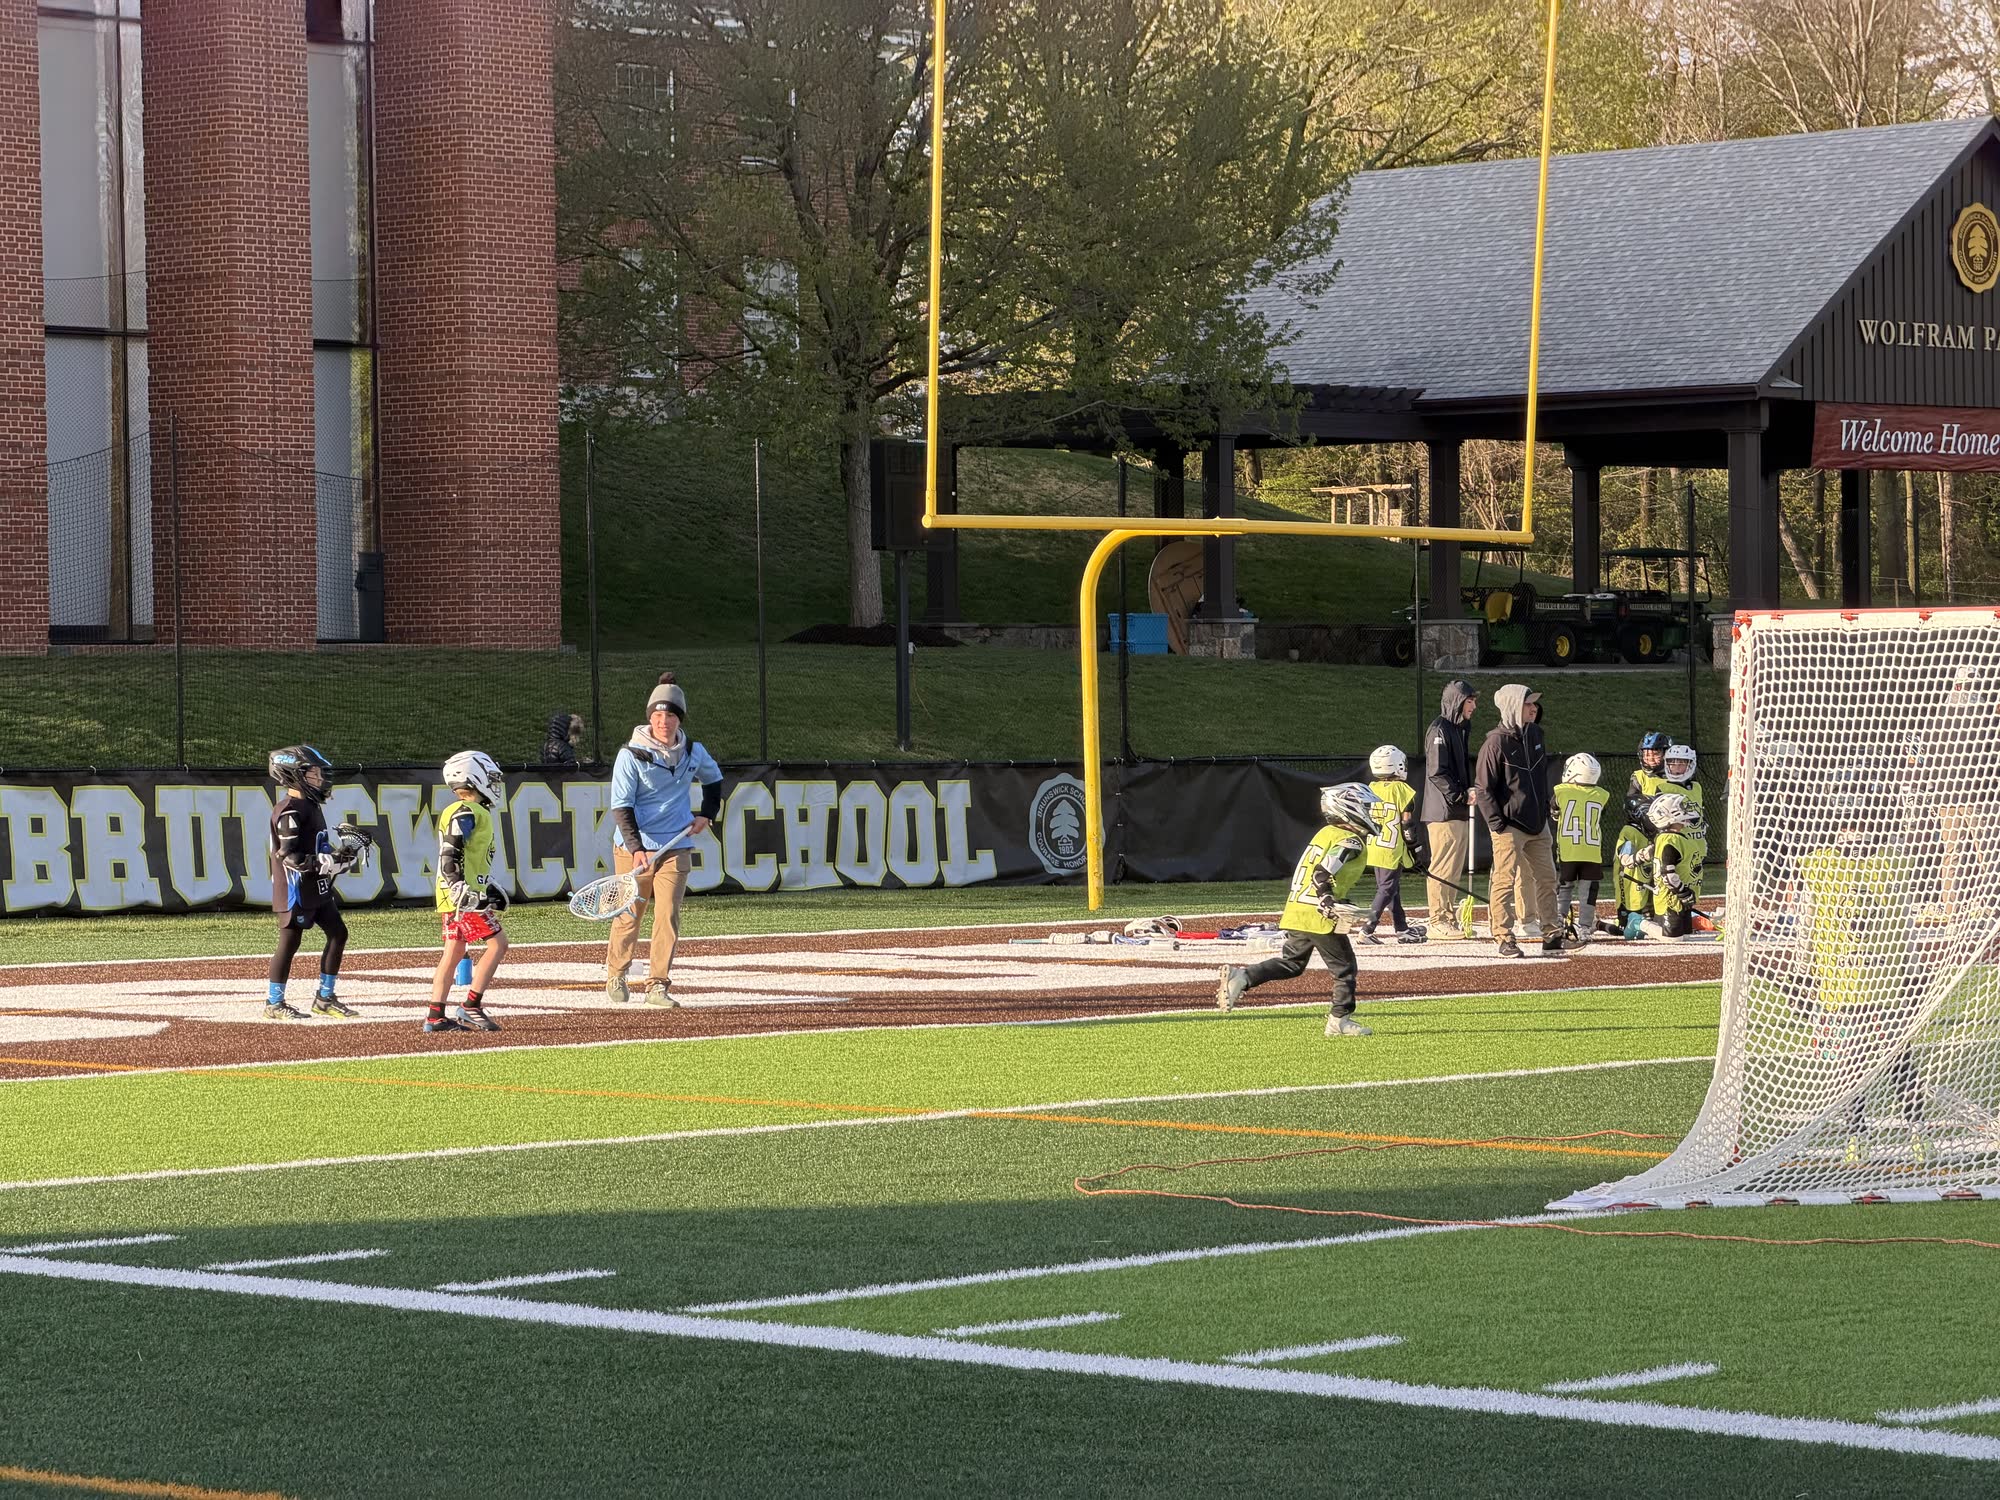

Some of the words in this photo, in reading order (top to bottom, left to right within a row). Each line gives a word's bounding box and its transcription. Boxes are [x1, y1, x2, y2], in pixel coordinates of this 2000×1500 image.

[1859, 319, 1975, 350] WOLFRAM
[1840, 418, 1934, 453] Welcome
[1938, 423, 2000, 455] Home
[1037, 785, 1069, 818] BRUNSWICK
[1561, 800, 1602, 847] 40
[1036, 831, 1060, 867] COURAGE
[1058, 845, 1074, 855] 1902
